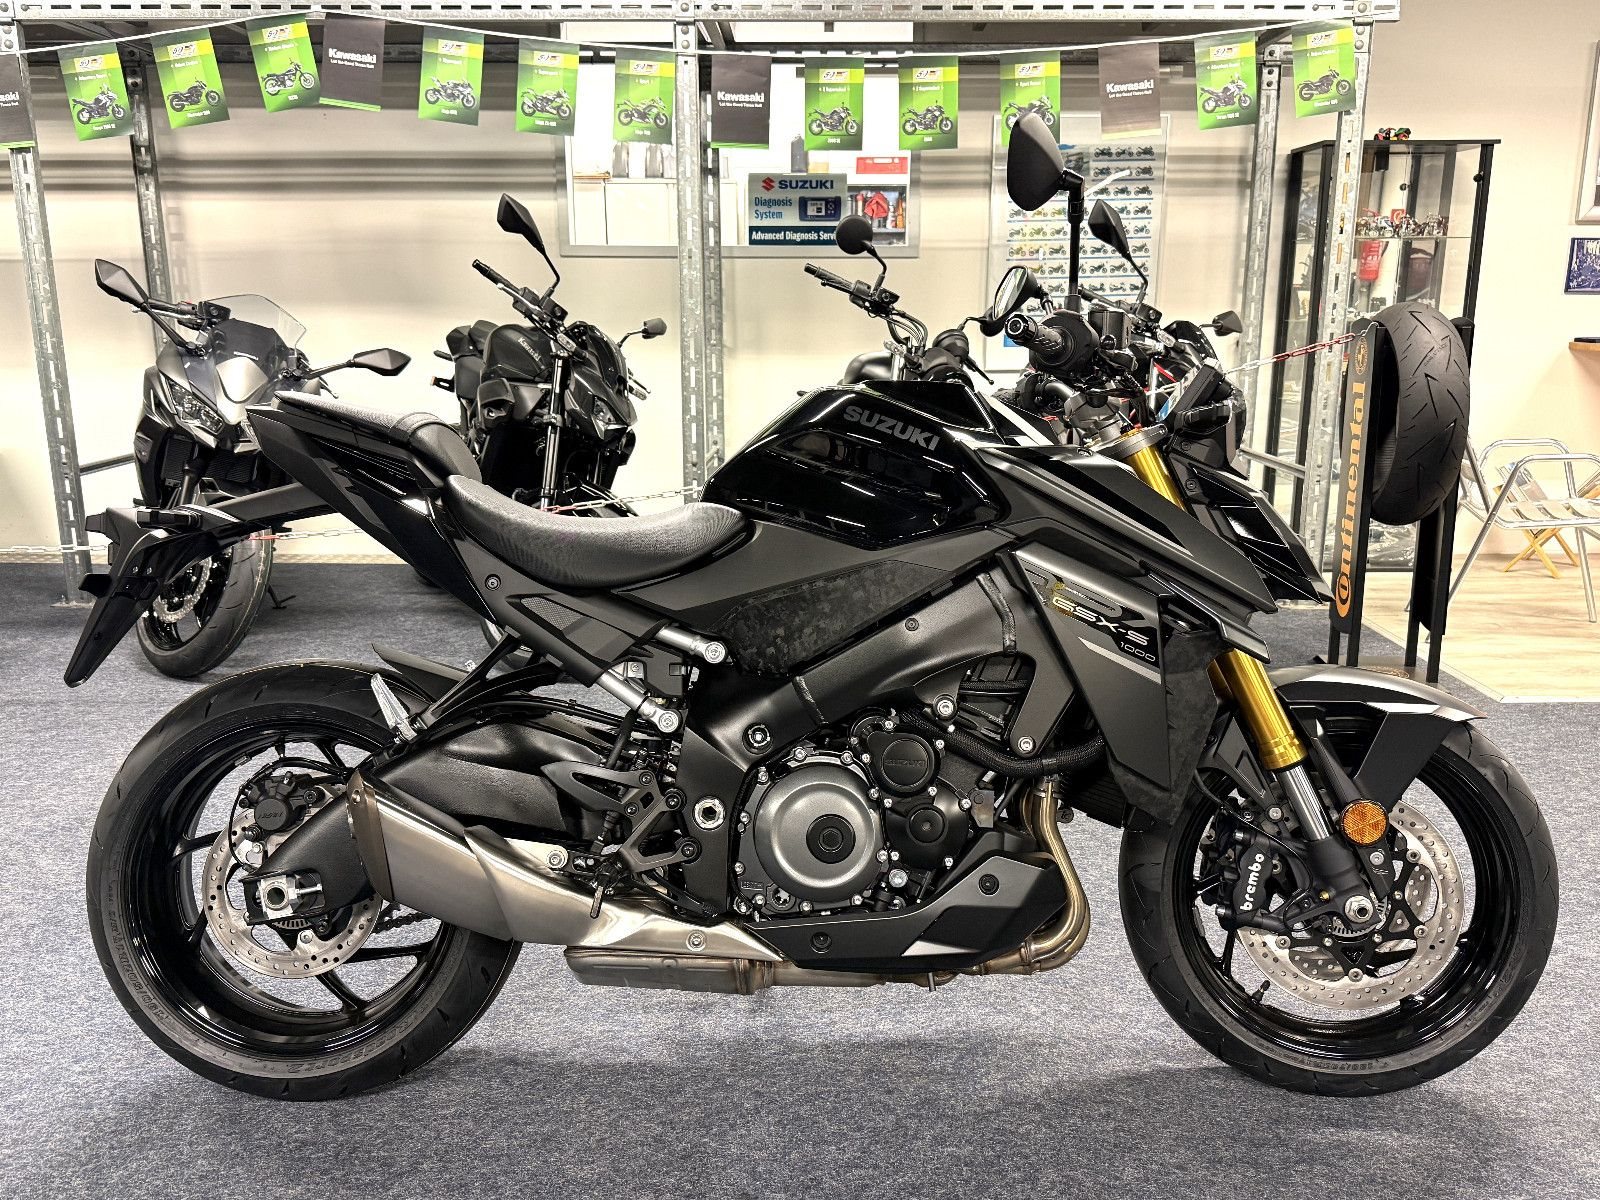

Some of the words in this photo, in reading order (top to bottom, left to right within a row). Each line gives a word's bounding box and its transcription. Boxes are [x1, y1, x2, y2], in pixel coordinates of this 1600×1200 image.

[328, 48, 377, 64] Kawasaki
[1106, 79, 1154, 94] Kawasaki
[717, 91, 765, 103] Kawasaki
[778, 179, 834, 190] SUZUKI
[754, 196, 793, 209] Diagnosis
[754, 209, 783, 221] System
[751, 230, 784, 241] Advanced
[785, 231, 818, 242] Diagnosis
[517, 336, 542, 362] Kawasaki
[843, 405, 941, 451] SUZUKI
[1336, 381, 1366, 617] Continental
[1053, 596, 1149, 646] GSX-S
[1119, 641, 1156, 662] 1000
[1240, 853, 1265, 911] brembo
